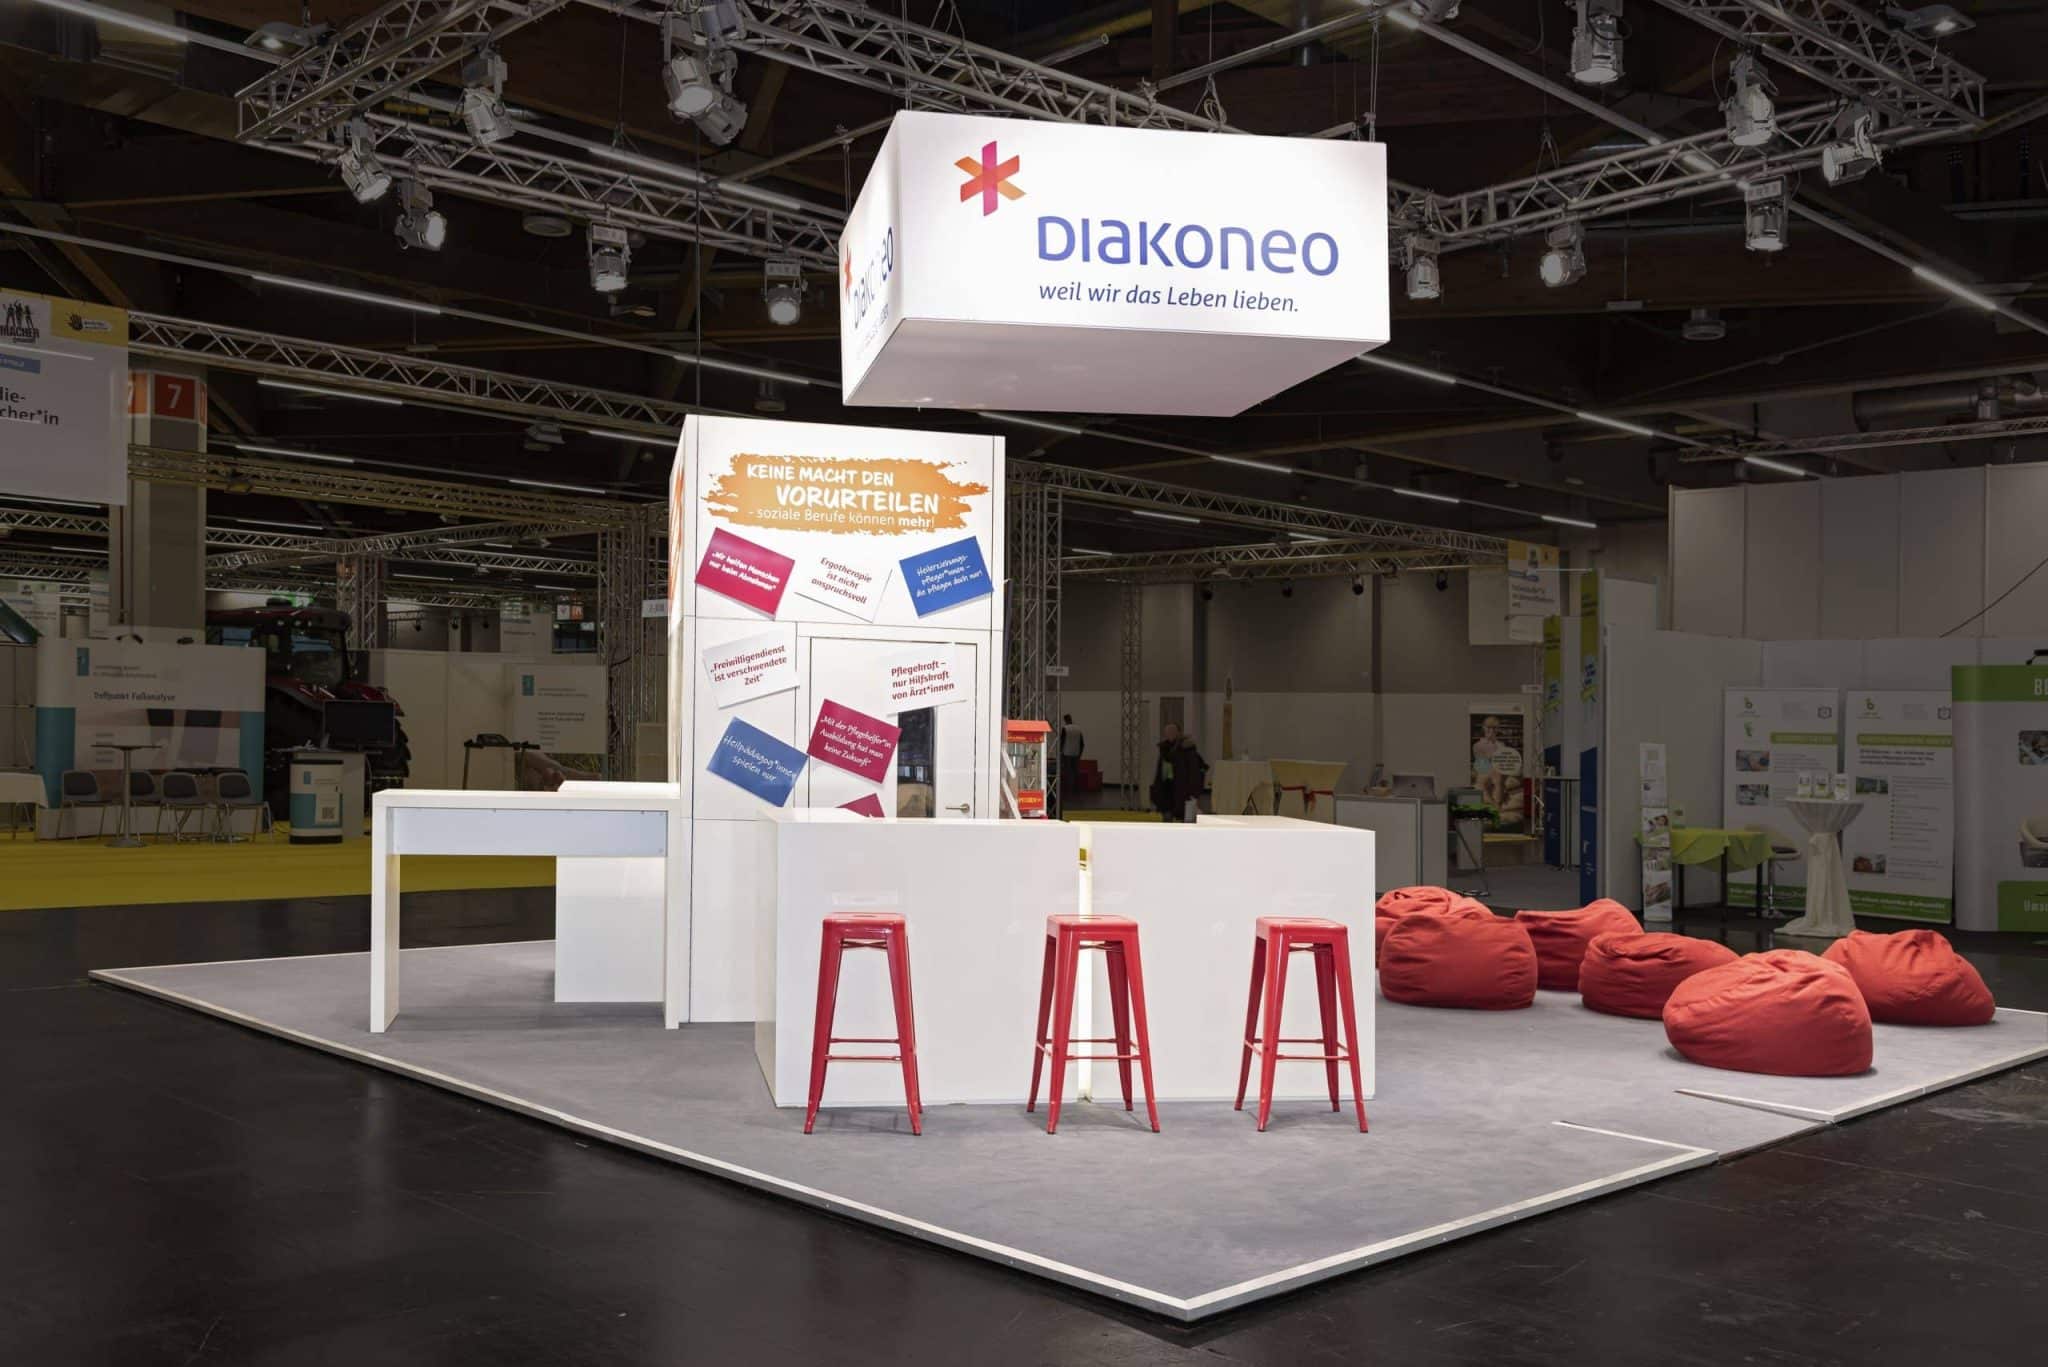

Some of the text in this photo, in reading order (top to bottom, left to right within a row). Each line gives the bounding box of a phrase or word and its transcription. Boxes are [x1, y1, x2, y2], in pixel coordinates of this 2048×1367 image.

[1039, 281, 1299, 312] weil wir das Leben lieben.
[168, 383, 182, 408] 7
[746, 464, 894, 487] KEINE MACHT DEN
[776, 484, 939, 514] VORURTEILEN
[757, 507, 800, 520] soziale
[805, 509, 845, 523] Berufe
[849, 512, 895, 526] können
[898, 516, 935, 528] mehr!
[820, 557, 872, 583] Ergotherapie
[826, 571, 858, 590] ist nicht
[811, 577, 868, 604] anspruchsvoll
[714, 657, 787, 682] ist verschwendete
[891, 660, 939, 677] Pflegekraft
[892, 670, 949, 688] nur Hilfskraft
[891, 690, 908, 700] von
